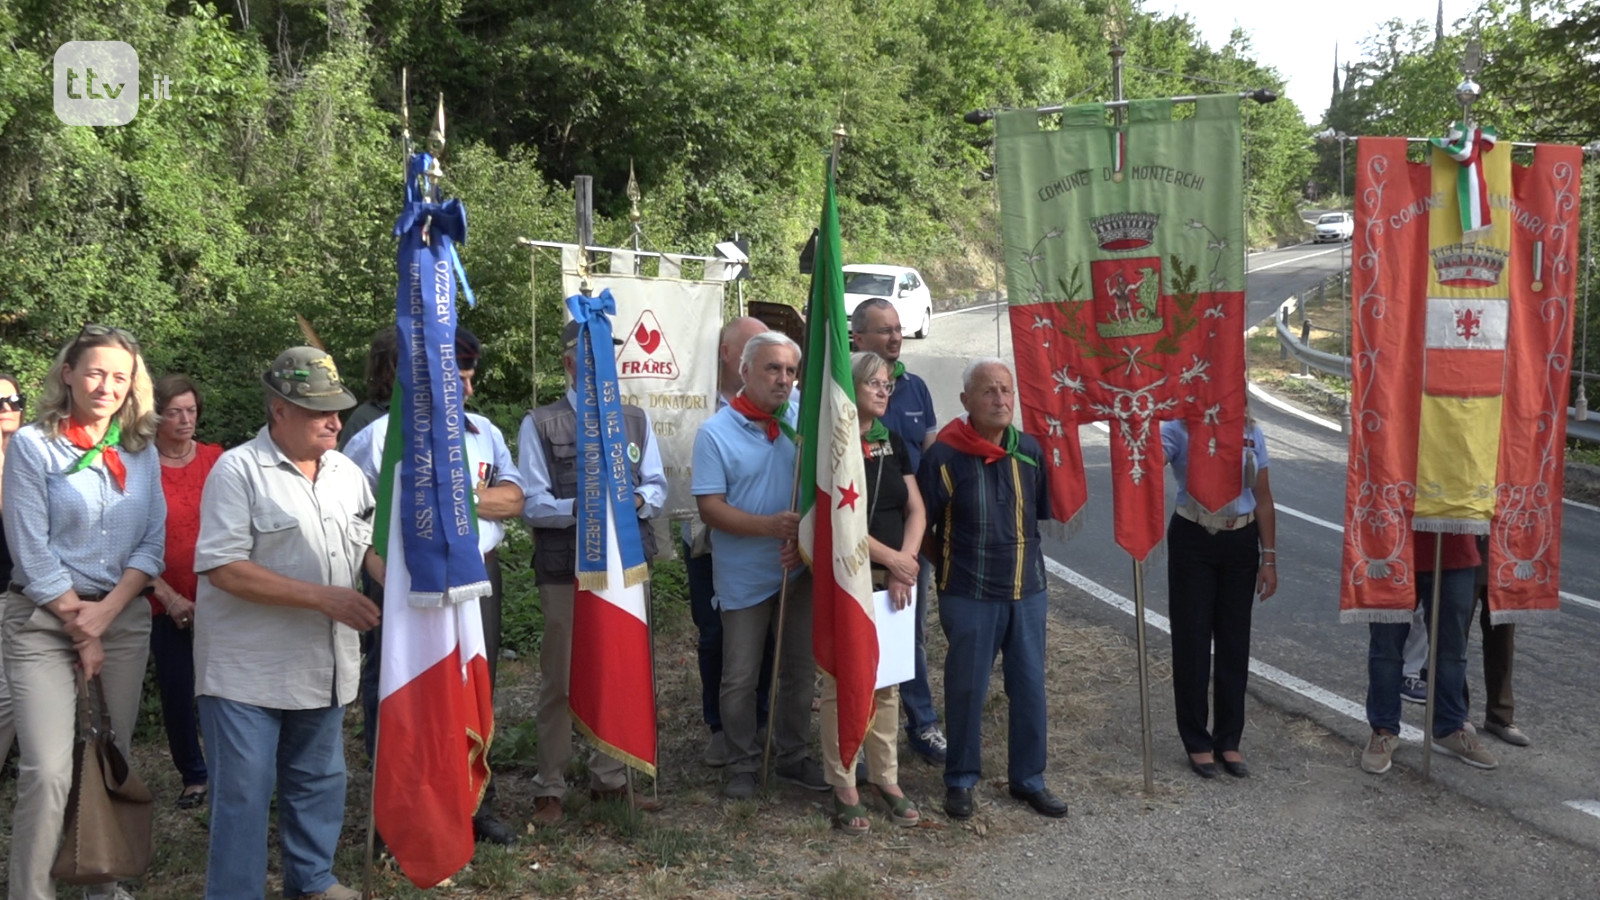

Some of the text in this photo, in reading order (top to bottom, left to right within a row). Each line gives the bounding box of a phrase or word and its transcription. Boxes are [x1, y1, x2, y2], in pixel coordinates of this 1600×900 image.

[1038, 171, 1090, 202] COMUNE
[1131, 166, 1205, 191] MONTERCHI
[1389, 191, 1447, 229] COMUNE
[434, 260, 451, 326] AREZZO
[412, 334, 432, 432] COMBATTENTI
[440, 343, 461, 441] MONTERCHI
[649, 393, 708, 410] DONATORI
[584, 412, 600, 438] LIDO
[603, 381, 630, 503] ASS. NAZ. FORESTALI
[415, 450, 433, 488] NAZ.
[448, 445, 463, 463] DI
[415, 490, 425, 506] NE
[451, 467, 470, 536] SEZIONE
[583, 443, 601, 562] MONDANELLI-AREZZO
[416, 506, 433, 540] ASS.
